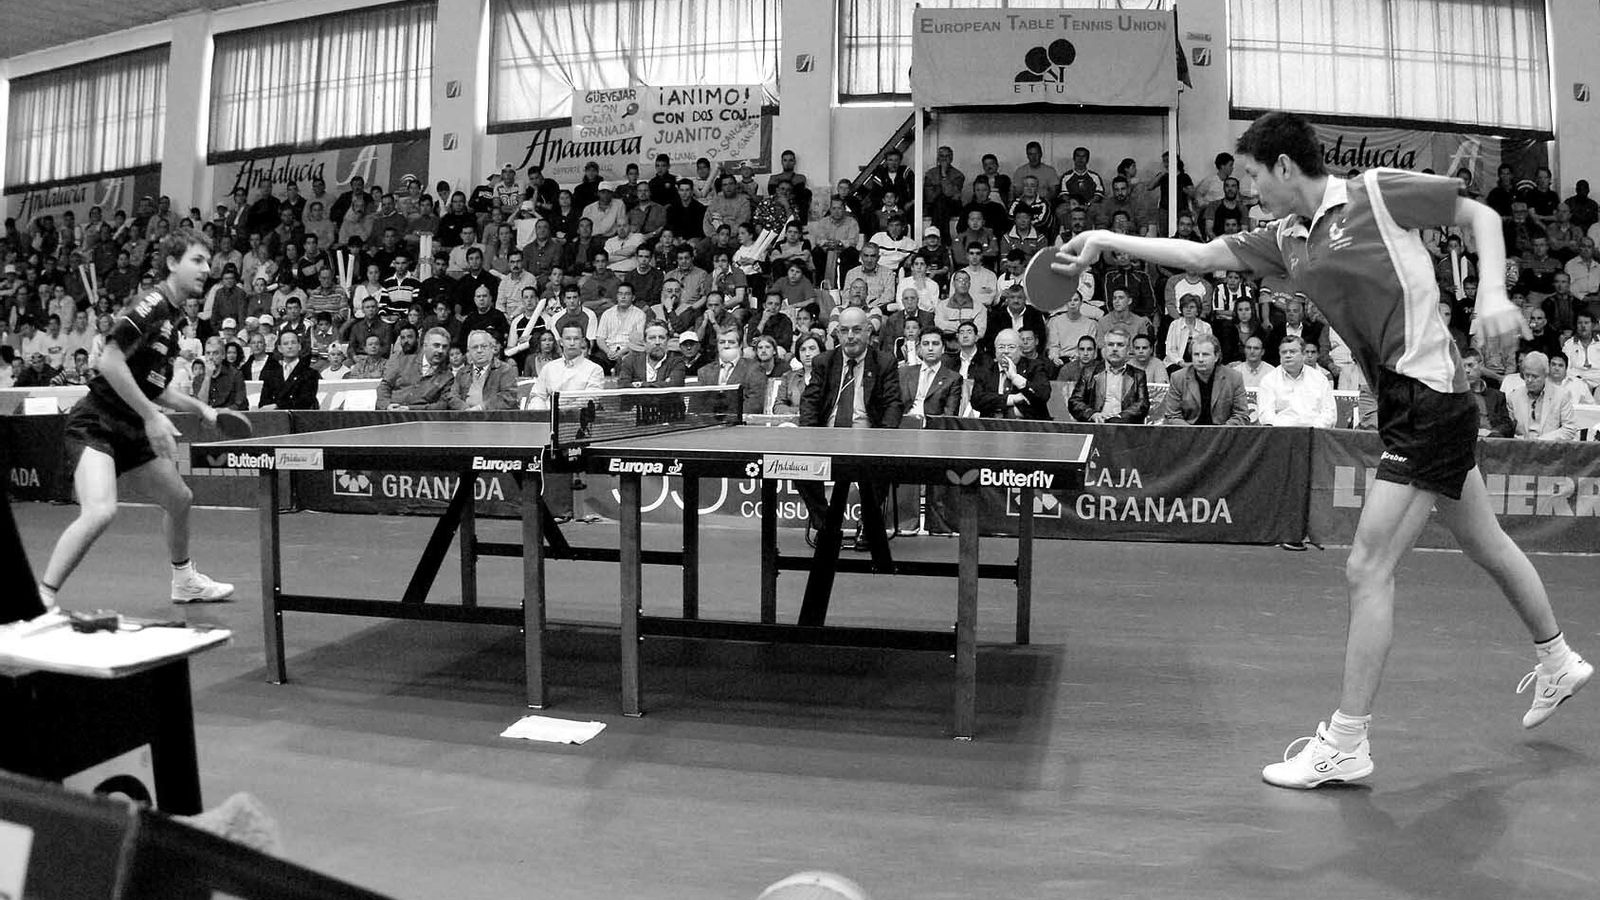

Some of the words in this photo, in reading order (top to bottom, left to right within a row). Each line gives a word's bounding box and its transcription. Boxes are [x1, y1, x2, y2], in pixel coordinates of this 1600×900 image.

[921, 18, 1001, 33] EUROPEAN
[1006, 15, 1054, 31] TABLE
[1059, 14, 1113, 31] TENNIS
[1118, 15, 1167, 32] UNION
[592, 104, 618, 115] CON
[653, 112, 684, 124] CON
[693, 110, 713, 122] DOS
[580, 122, 636, 139] GRANADA
[655, 126, 721, 144] JUANITO
[228, 453, 275, 470] Butterfly
[472, 456, 522, 473] Europa
[608, 458, 663, 475] Europa
[980, 468, 1054, 489] Butterfly
[1076, 493, 1232, 524] GRANADA
